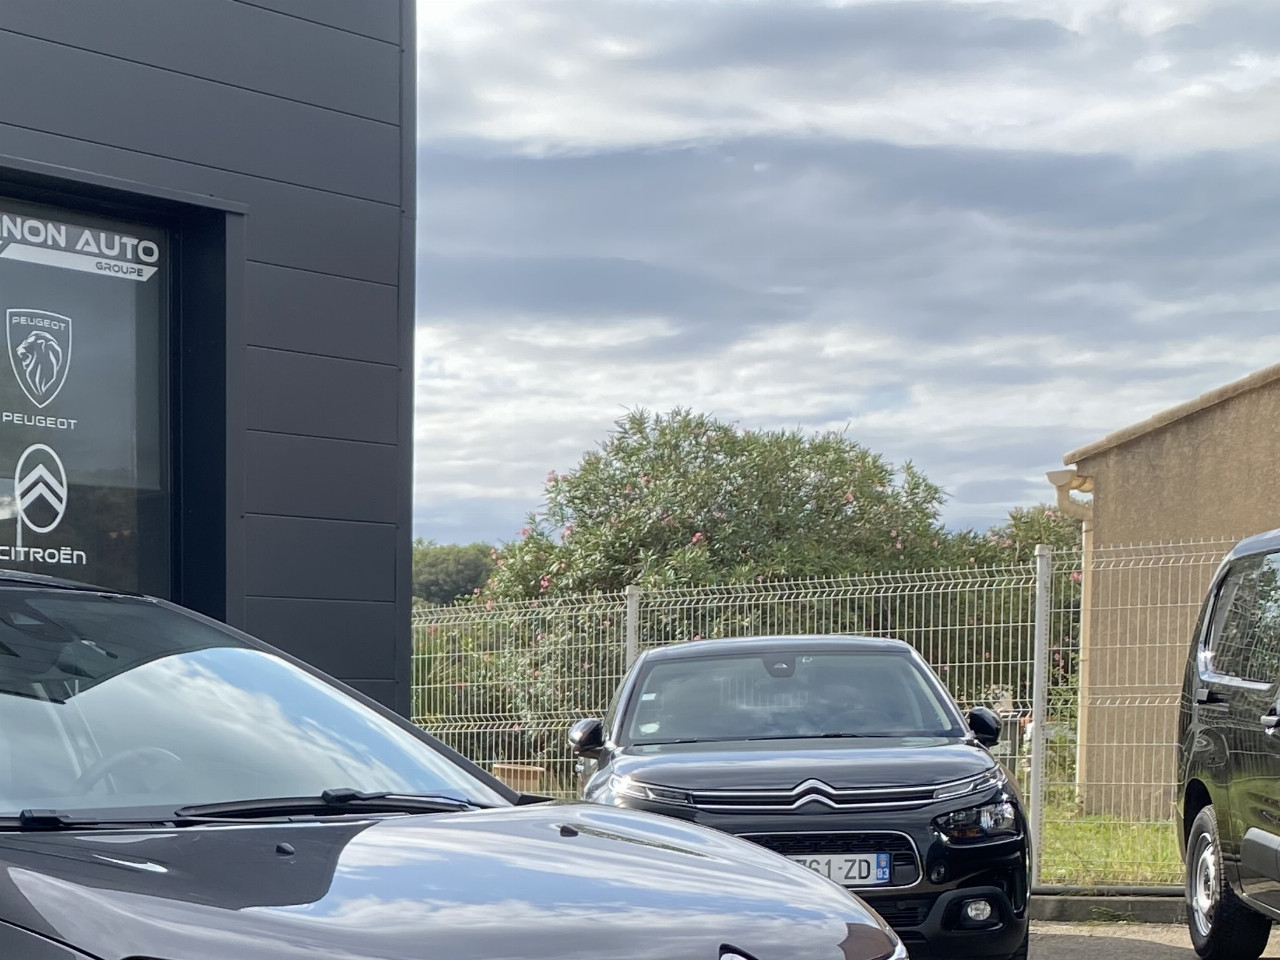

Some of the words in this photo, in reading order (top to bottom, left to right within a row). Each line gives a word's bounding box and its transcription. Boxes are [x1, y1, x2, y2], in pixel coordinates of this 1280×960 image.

[73, 228, 160, 264] AUTO
[94, 260, 145, 278] GROUPE
[11, 316, 67, 331] PEUGEOT
[2, 411, 78, 430] PEUGEOT
